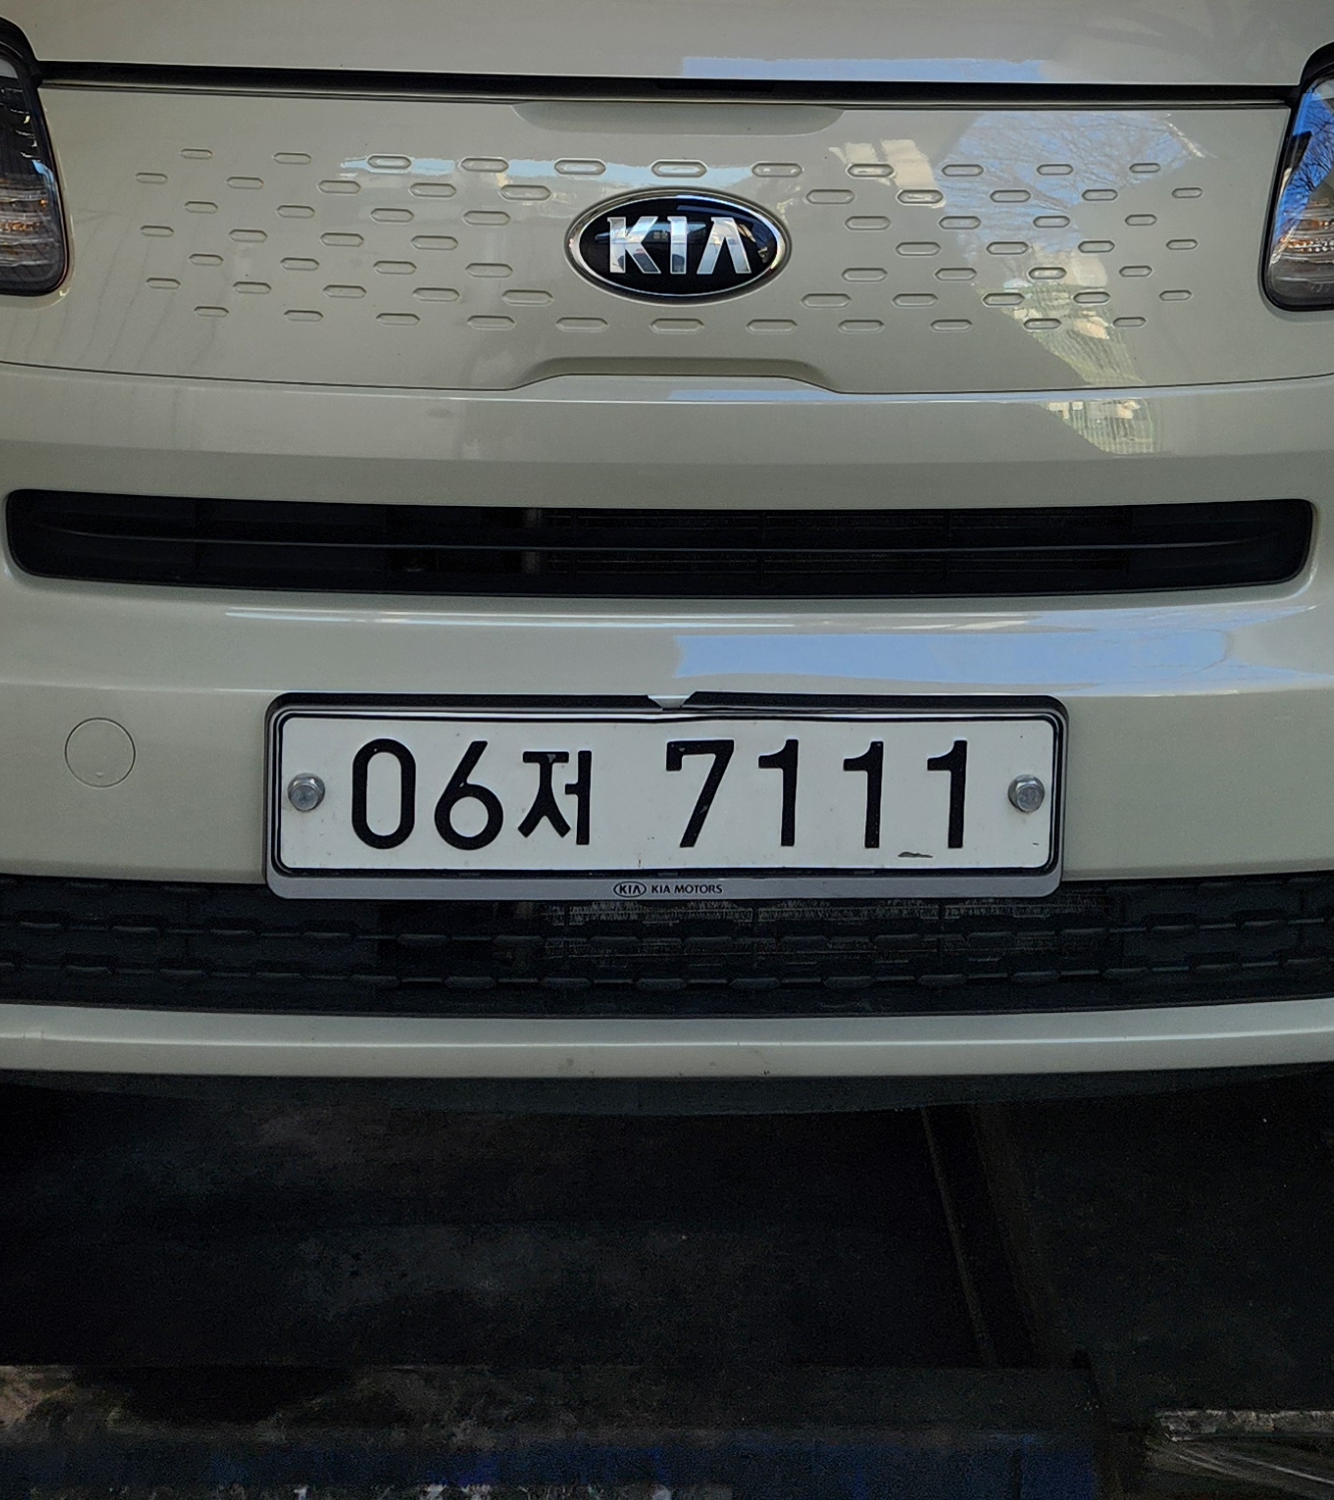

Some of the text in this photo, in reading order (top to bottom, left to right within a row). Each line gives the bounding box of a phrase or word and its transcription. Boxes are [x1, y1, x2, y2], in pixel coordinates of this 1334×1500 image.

[607, 216, 752, 275] KIA
[350, 737, 969, 851] 06저 7111
[619, 884, 723, 894] KIA KIA MOTORS
